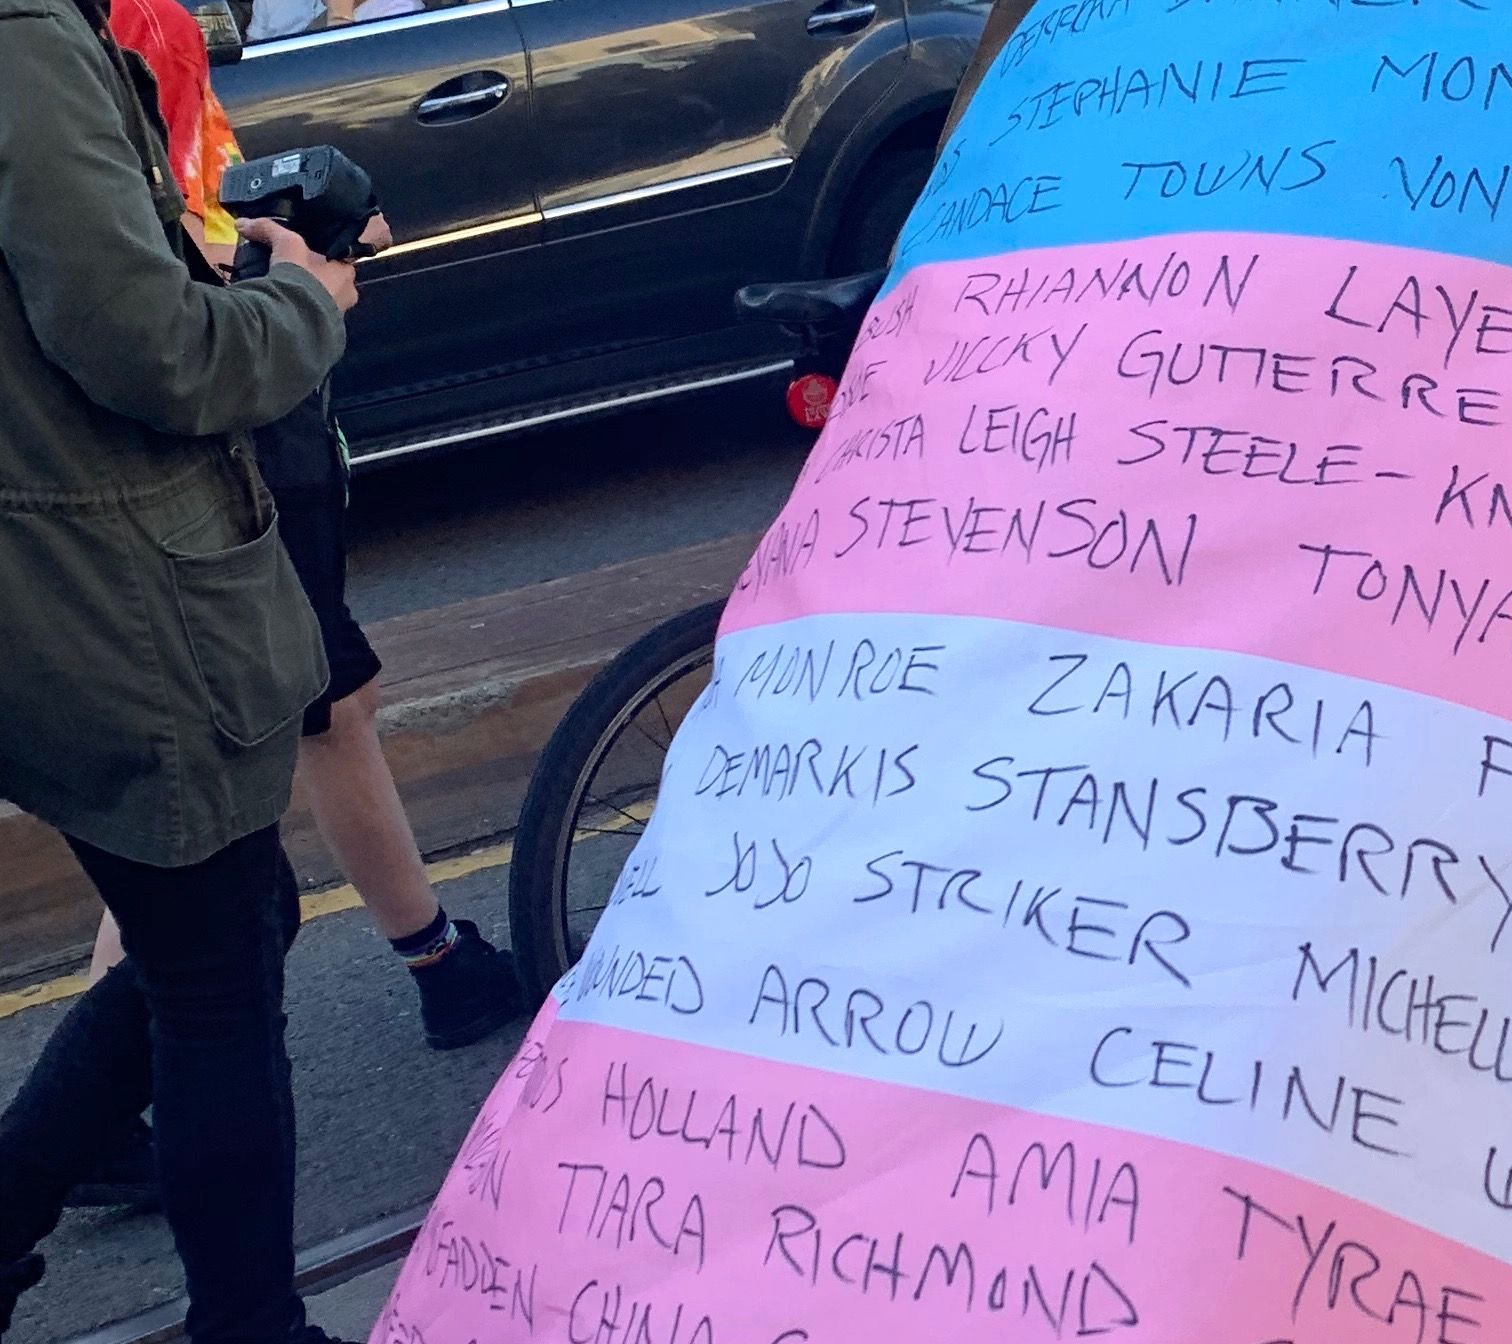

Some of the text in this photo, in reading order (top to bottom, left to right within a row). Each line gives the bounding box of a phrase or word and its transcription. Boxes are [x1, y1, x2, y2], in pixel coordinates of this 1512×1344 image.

[988, 59, 1308, 147] STEPHANIE
[1121, 139, 1336, 201] TOWNS
[953, 252, 1259, 315] RHIANNON
[958, 404, 1077, 474] LEIGH
[834, 496, 1197, 586] STEVENSON
[734, 639, 946, 702] MONROE
[1027, 654, 1391, 767] ZAKARIA
[694, 738, 919, 808] DEMARKIS
[853, 850, 1192, 990] STRIKER
[749, 964, 1004, 1067] ARROW
[1090, 1026, 1415, 1158] CELINE
[602, 1061, 847, 1172] HOLLAND
[950, 1132, 1140, 1244] AMIA
[558, 1162, 705, 1275] TIARA
[763, 1204, 1139, 1340] RICHMOND
